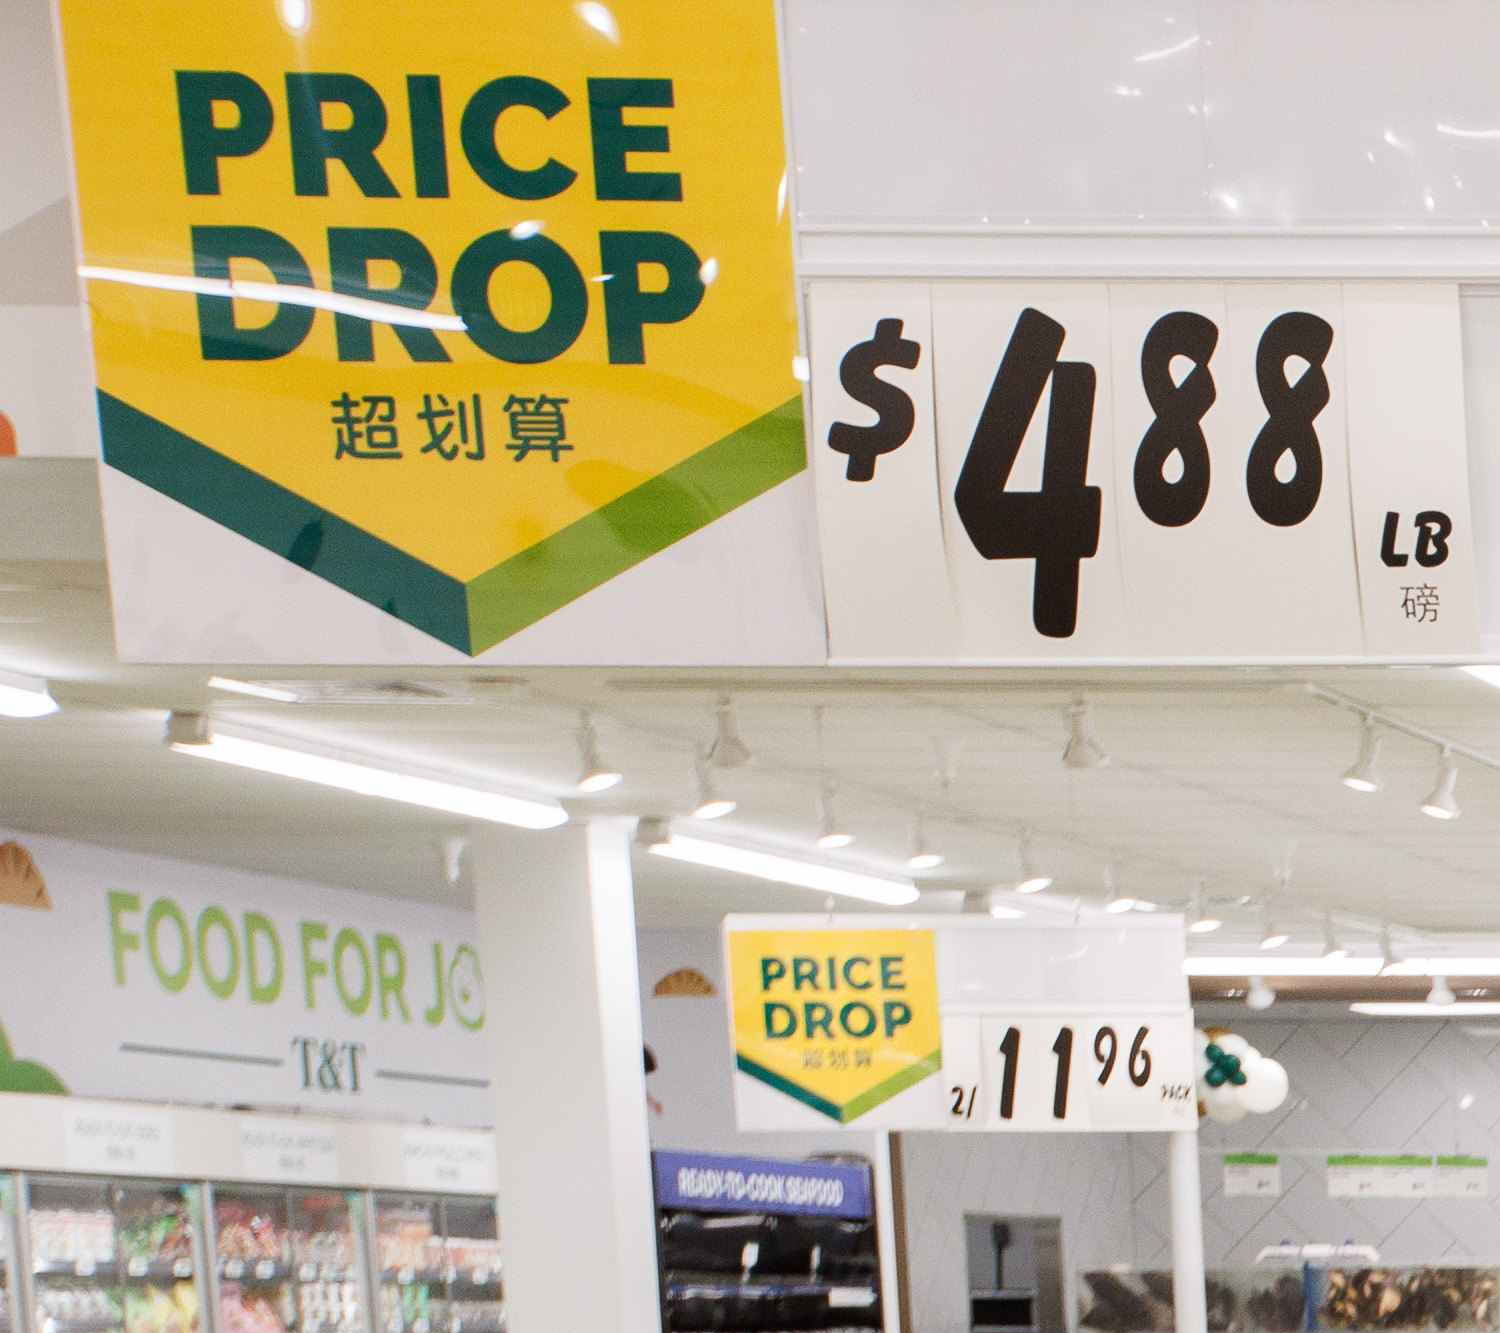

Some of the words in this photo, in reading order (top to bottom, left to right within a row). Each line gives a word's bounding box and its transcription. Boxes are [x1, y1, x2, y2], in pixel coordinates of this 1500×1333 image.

[173, 69, 687, 203] PRICE
[190, 225, 707, 365] DROP
[329, 389, 577, 466] 超划算
[1379, 510, 1454, 571] LB
[1400, 583, 1441, 624] 磅
[107, 889, 285, 1005] FOOD
[299, 920, 412, 1022] FOR
[760, 955, 905, 991] PRICE
[763, 1000, 912, 1041] DROP
[290, 1036, 366, 1094] T&T
